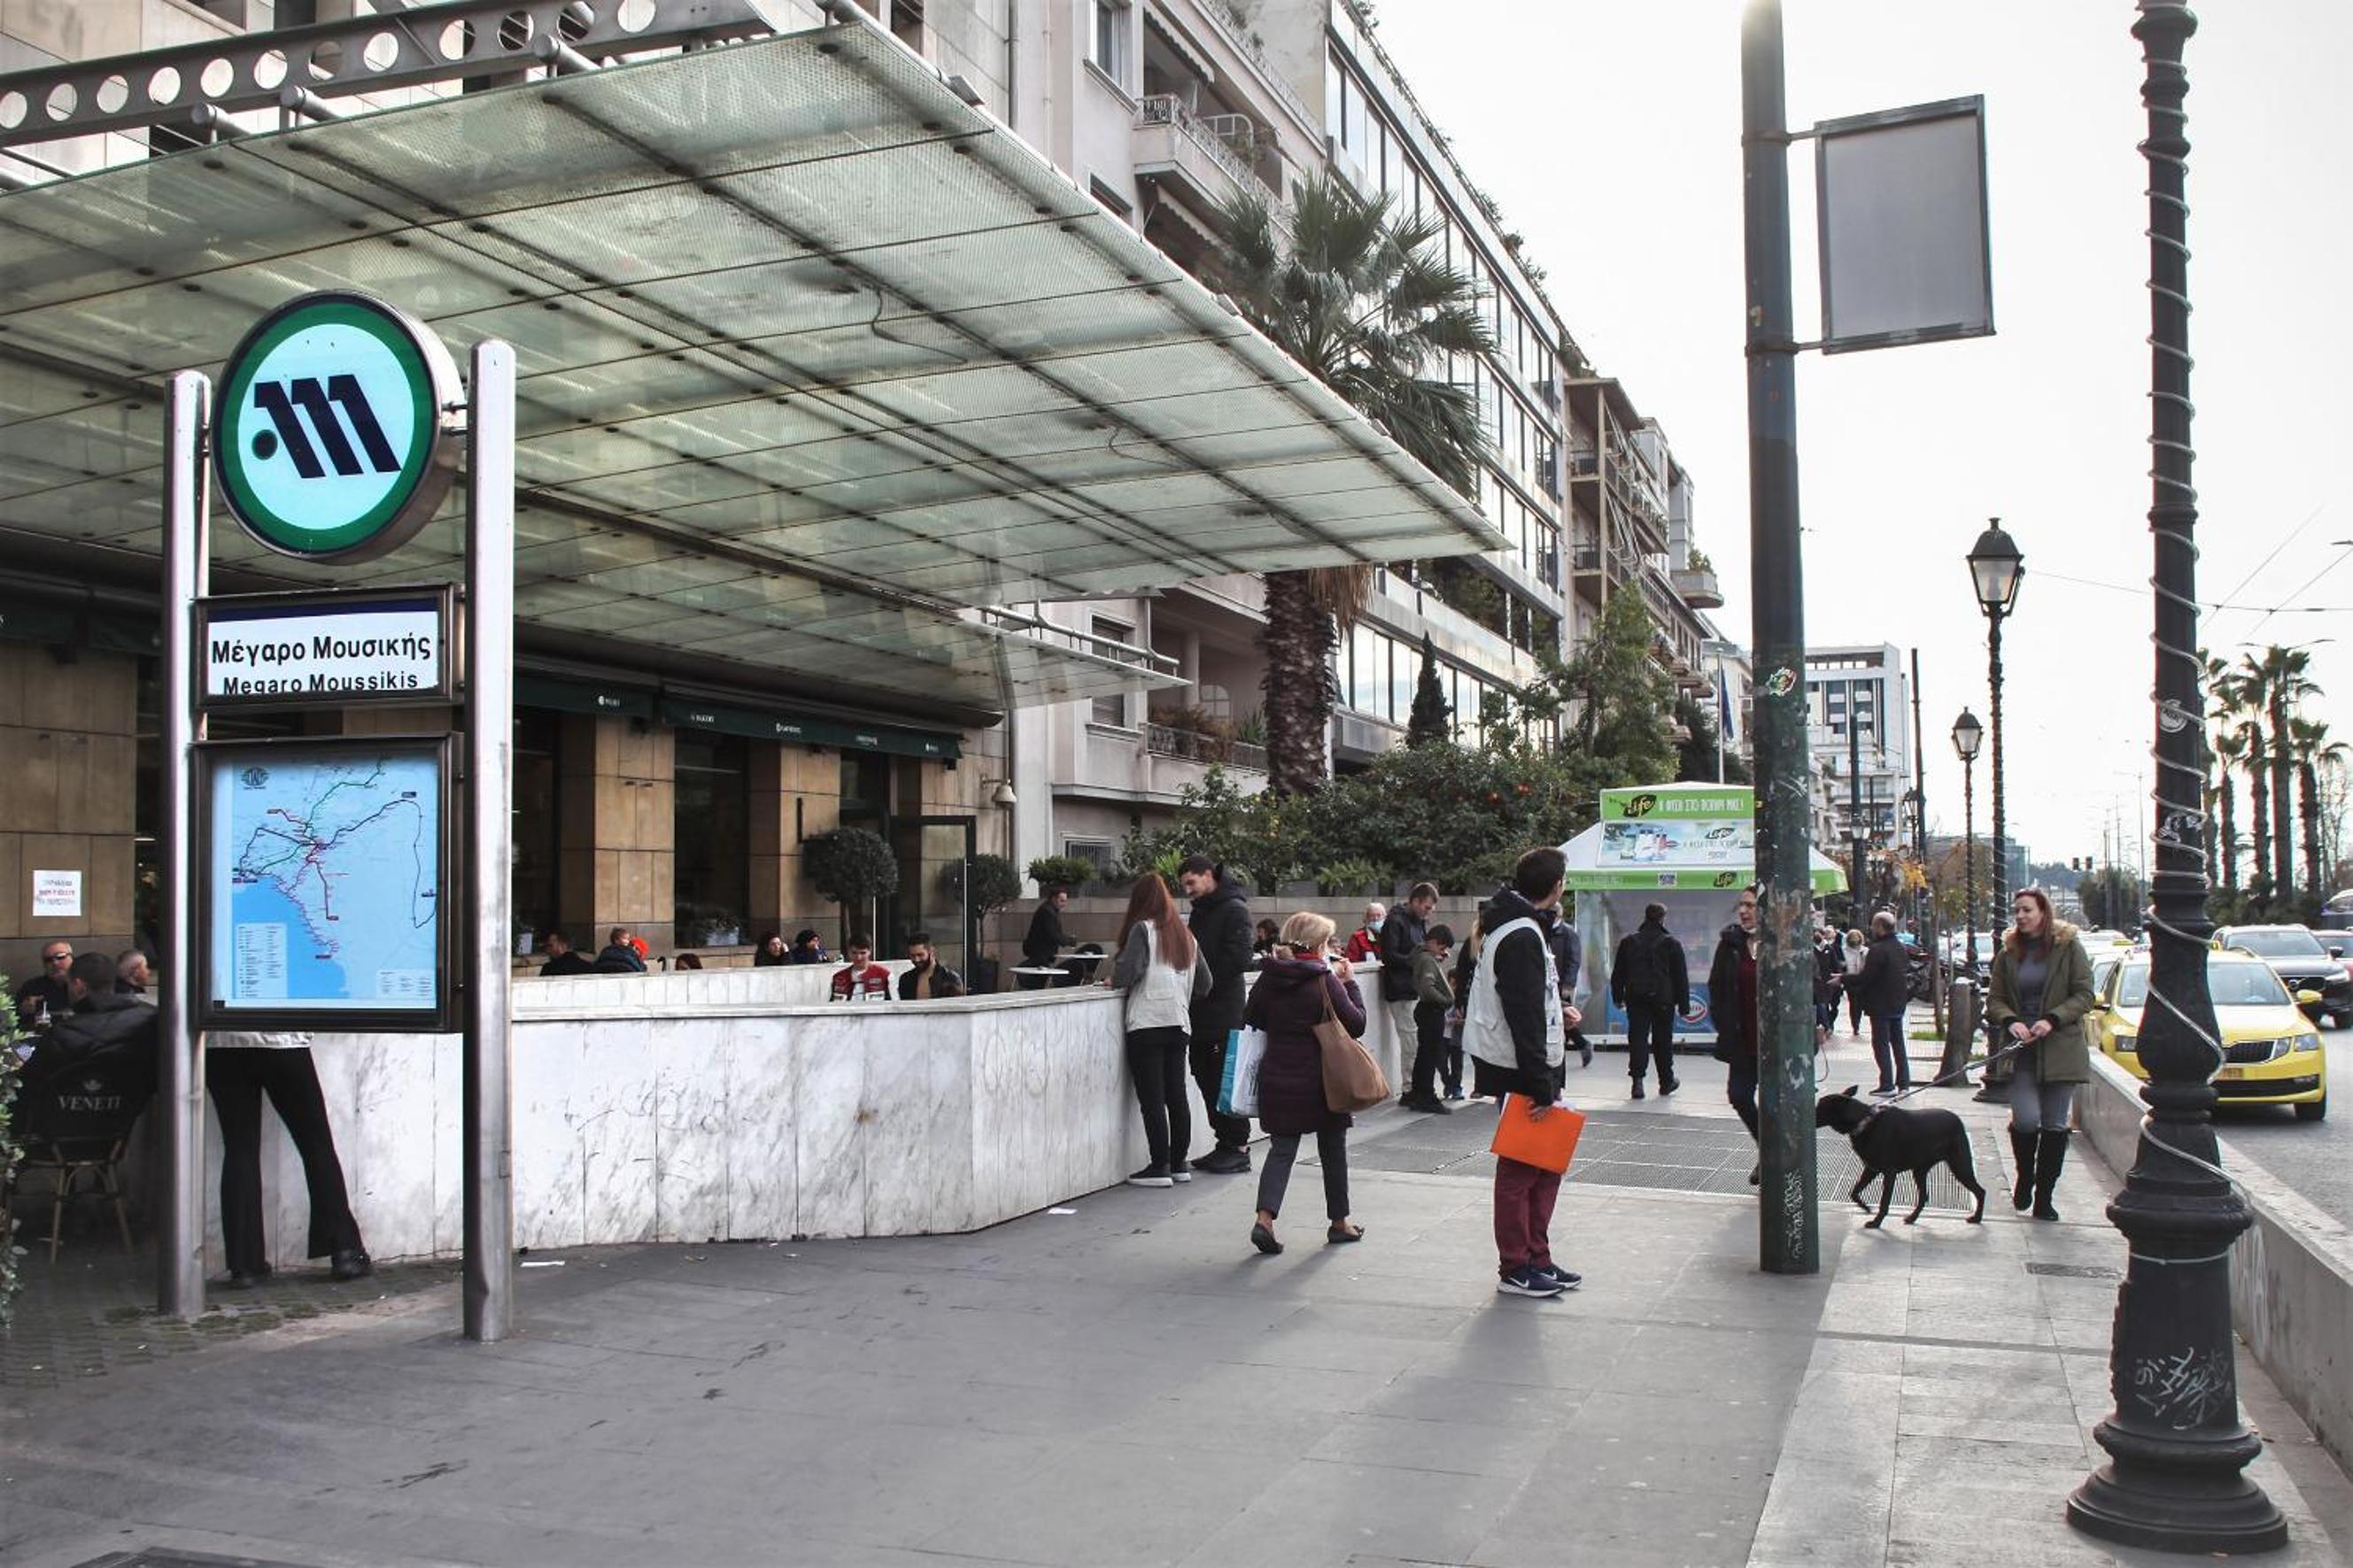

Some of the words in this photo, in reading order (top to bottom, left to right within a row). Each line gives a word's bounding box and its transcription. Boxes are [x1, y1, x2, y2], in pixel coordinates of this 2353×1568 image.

[212, 638, 306, 667] Μέγαρο
[313, 632, 432, 660] Μουσικής
[223, 675, 303, 696] Megaro
[309, 670, 419, 691] Moussikis
[58, 1094, 122, 1111] VENETI
